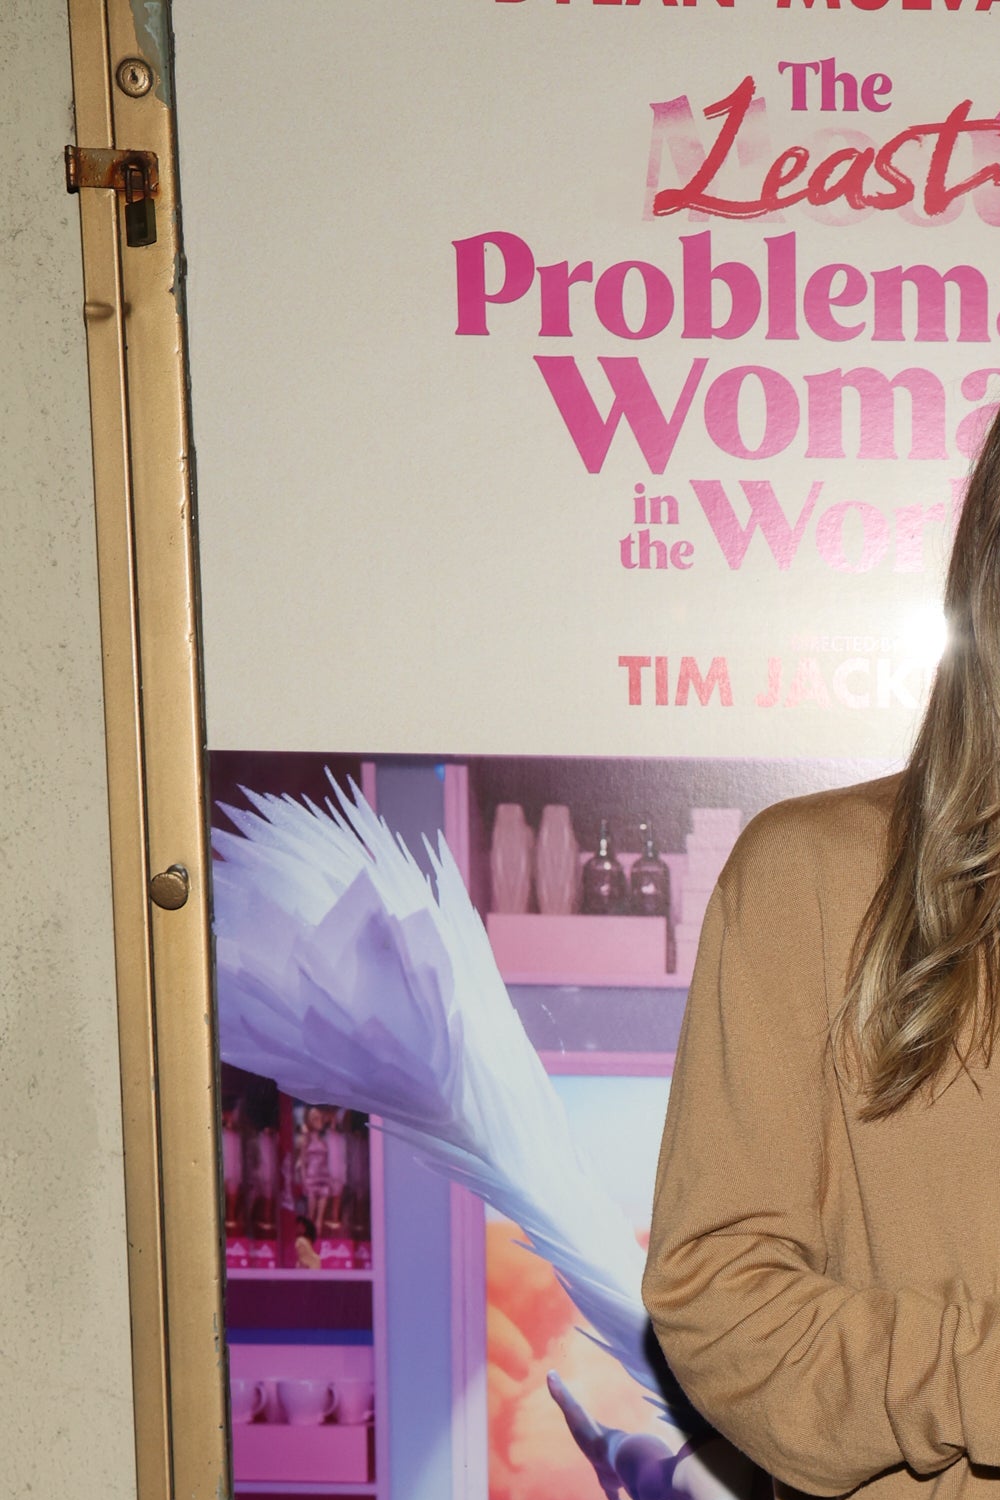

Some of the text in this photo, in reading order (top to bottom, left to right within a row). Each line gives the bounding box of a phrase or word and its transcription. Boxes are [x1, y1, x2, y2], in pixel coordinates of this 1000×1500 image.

[778, 57, 893, 113] The
[633, 482, 679, 525] in
[689, 479, 973, 574] Wor
[619, 529, 695, 570] the
[618, 655, 919, 709] TIM JACK
